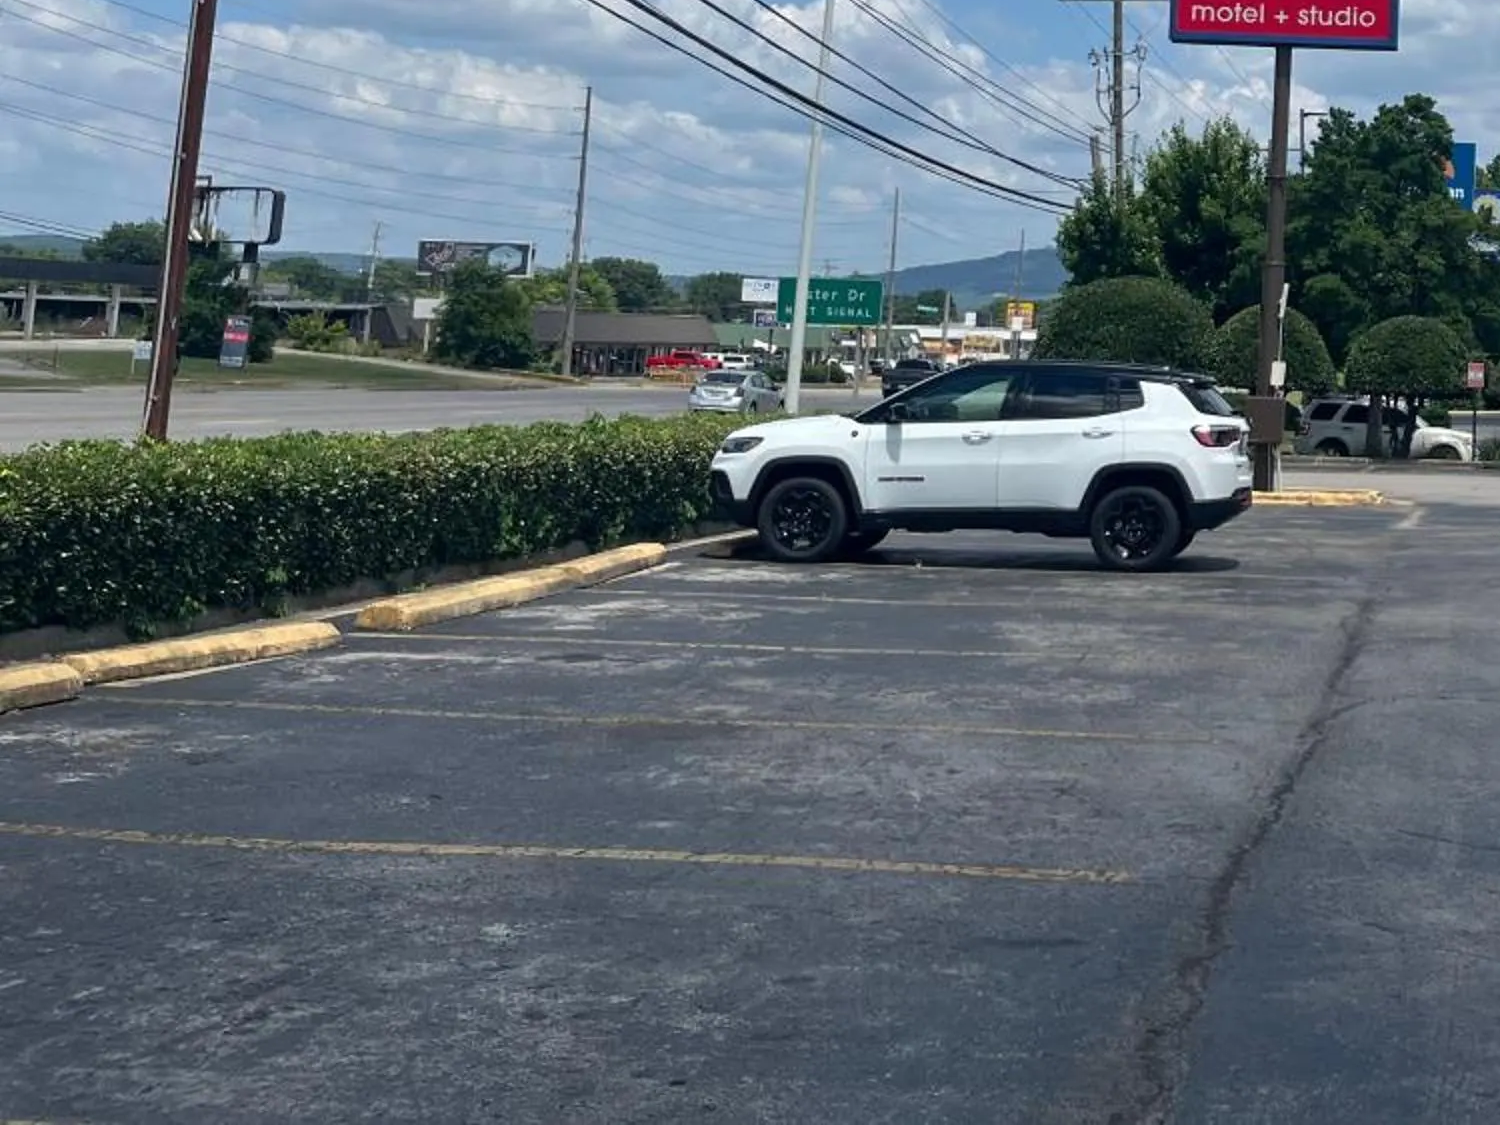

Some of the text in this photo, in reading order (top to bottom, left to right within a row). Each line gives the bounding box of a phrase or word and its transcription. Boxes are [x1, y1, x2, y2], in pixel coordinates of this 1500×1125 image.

[1190, 3, 1266, 24] motel
[1297, 5, 1377, 27] studio
[848, 289, 866, 302] Dr
[785, 303, 872, 318] NT SIGNAL
